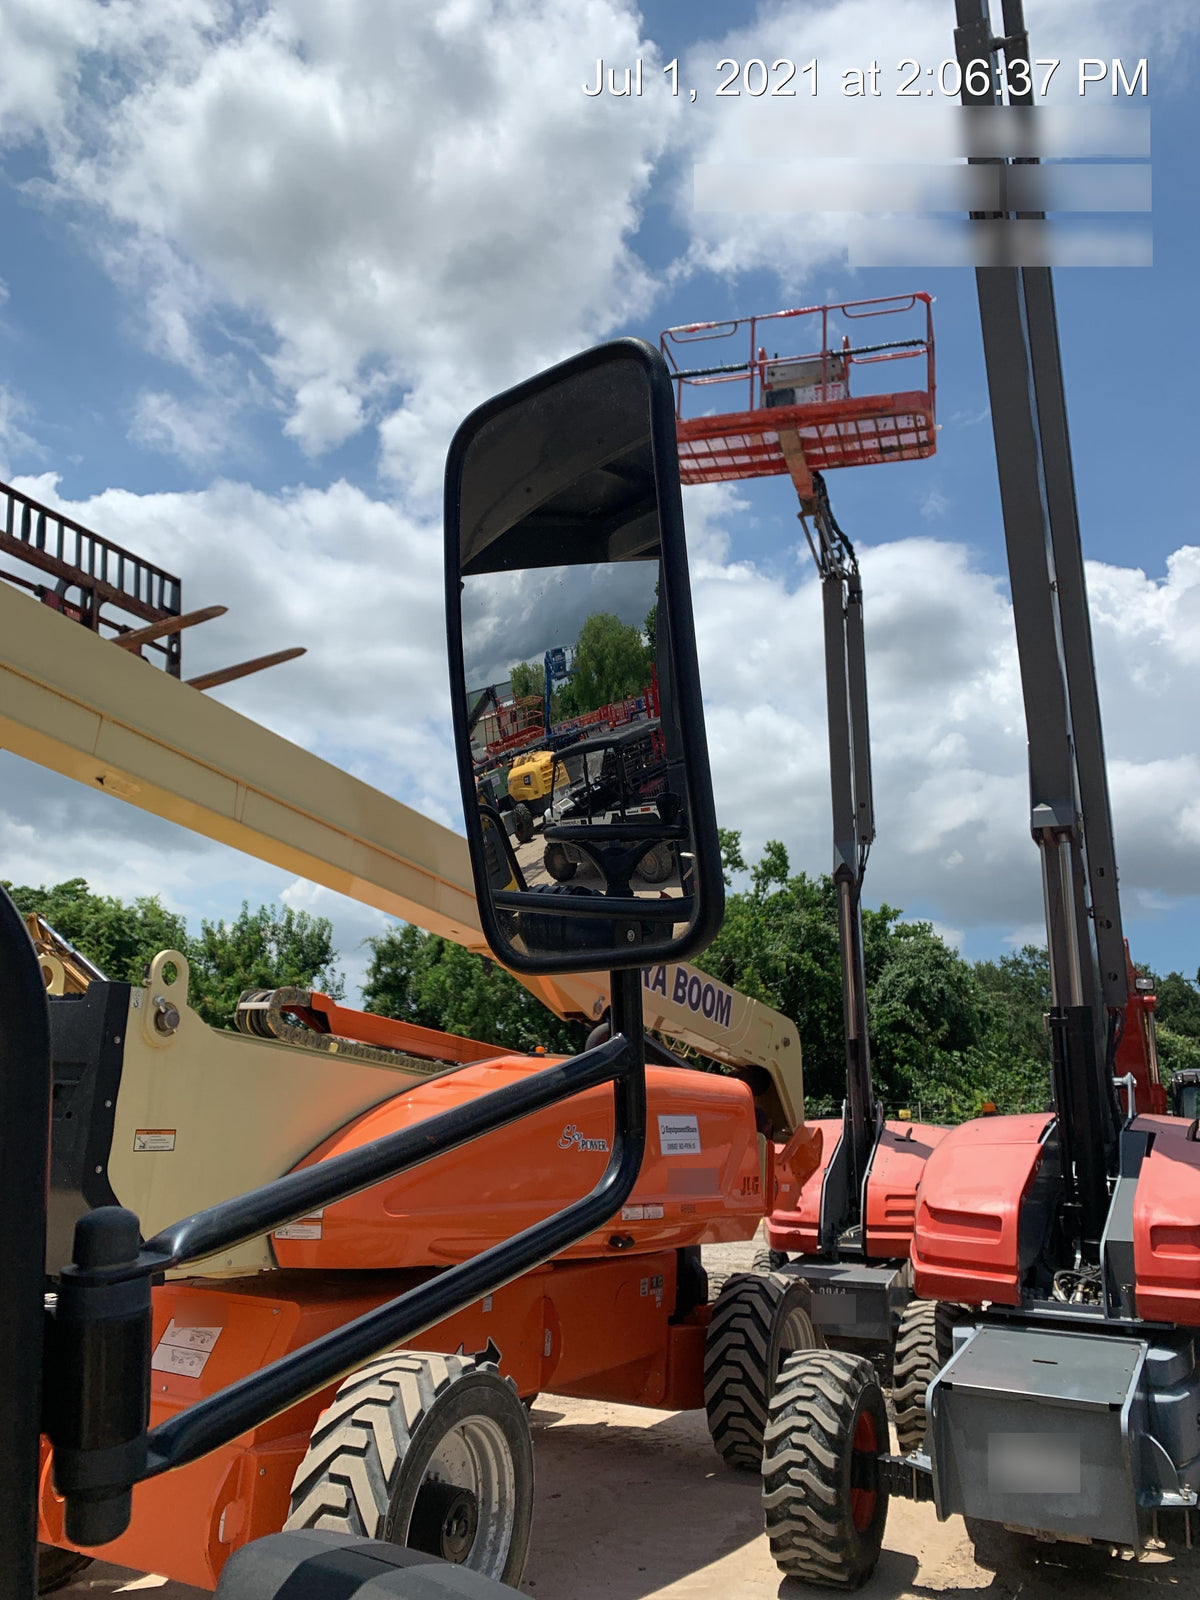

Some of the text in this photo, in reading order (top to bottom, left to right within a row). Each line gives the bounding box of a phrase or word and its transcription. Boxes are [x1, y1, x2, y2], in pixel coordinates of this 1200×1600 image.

[672, 965, 733, 1028] BOOM
[579, 1138, 608, 1152] POWER
[740, 1175, 760, 1196] JLG
